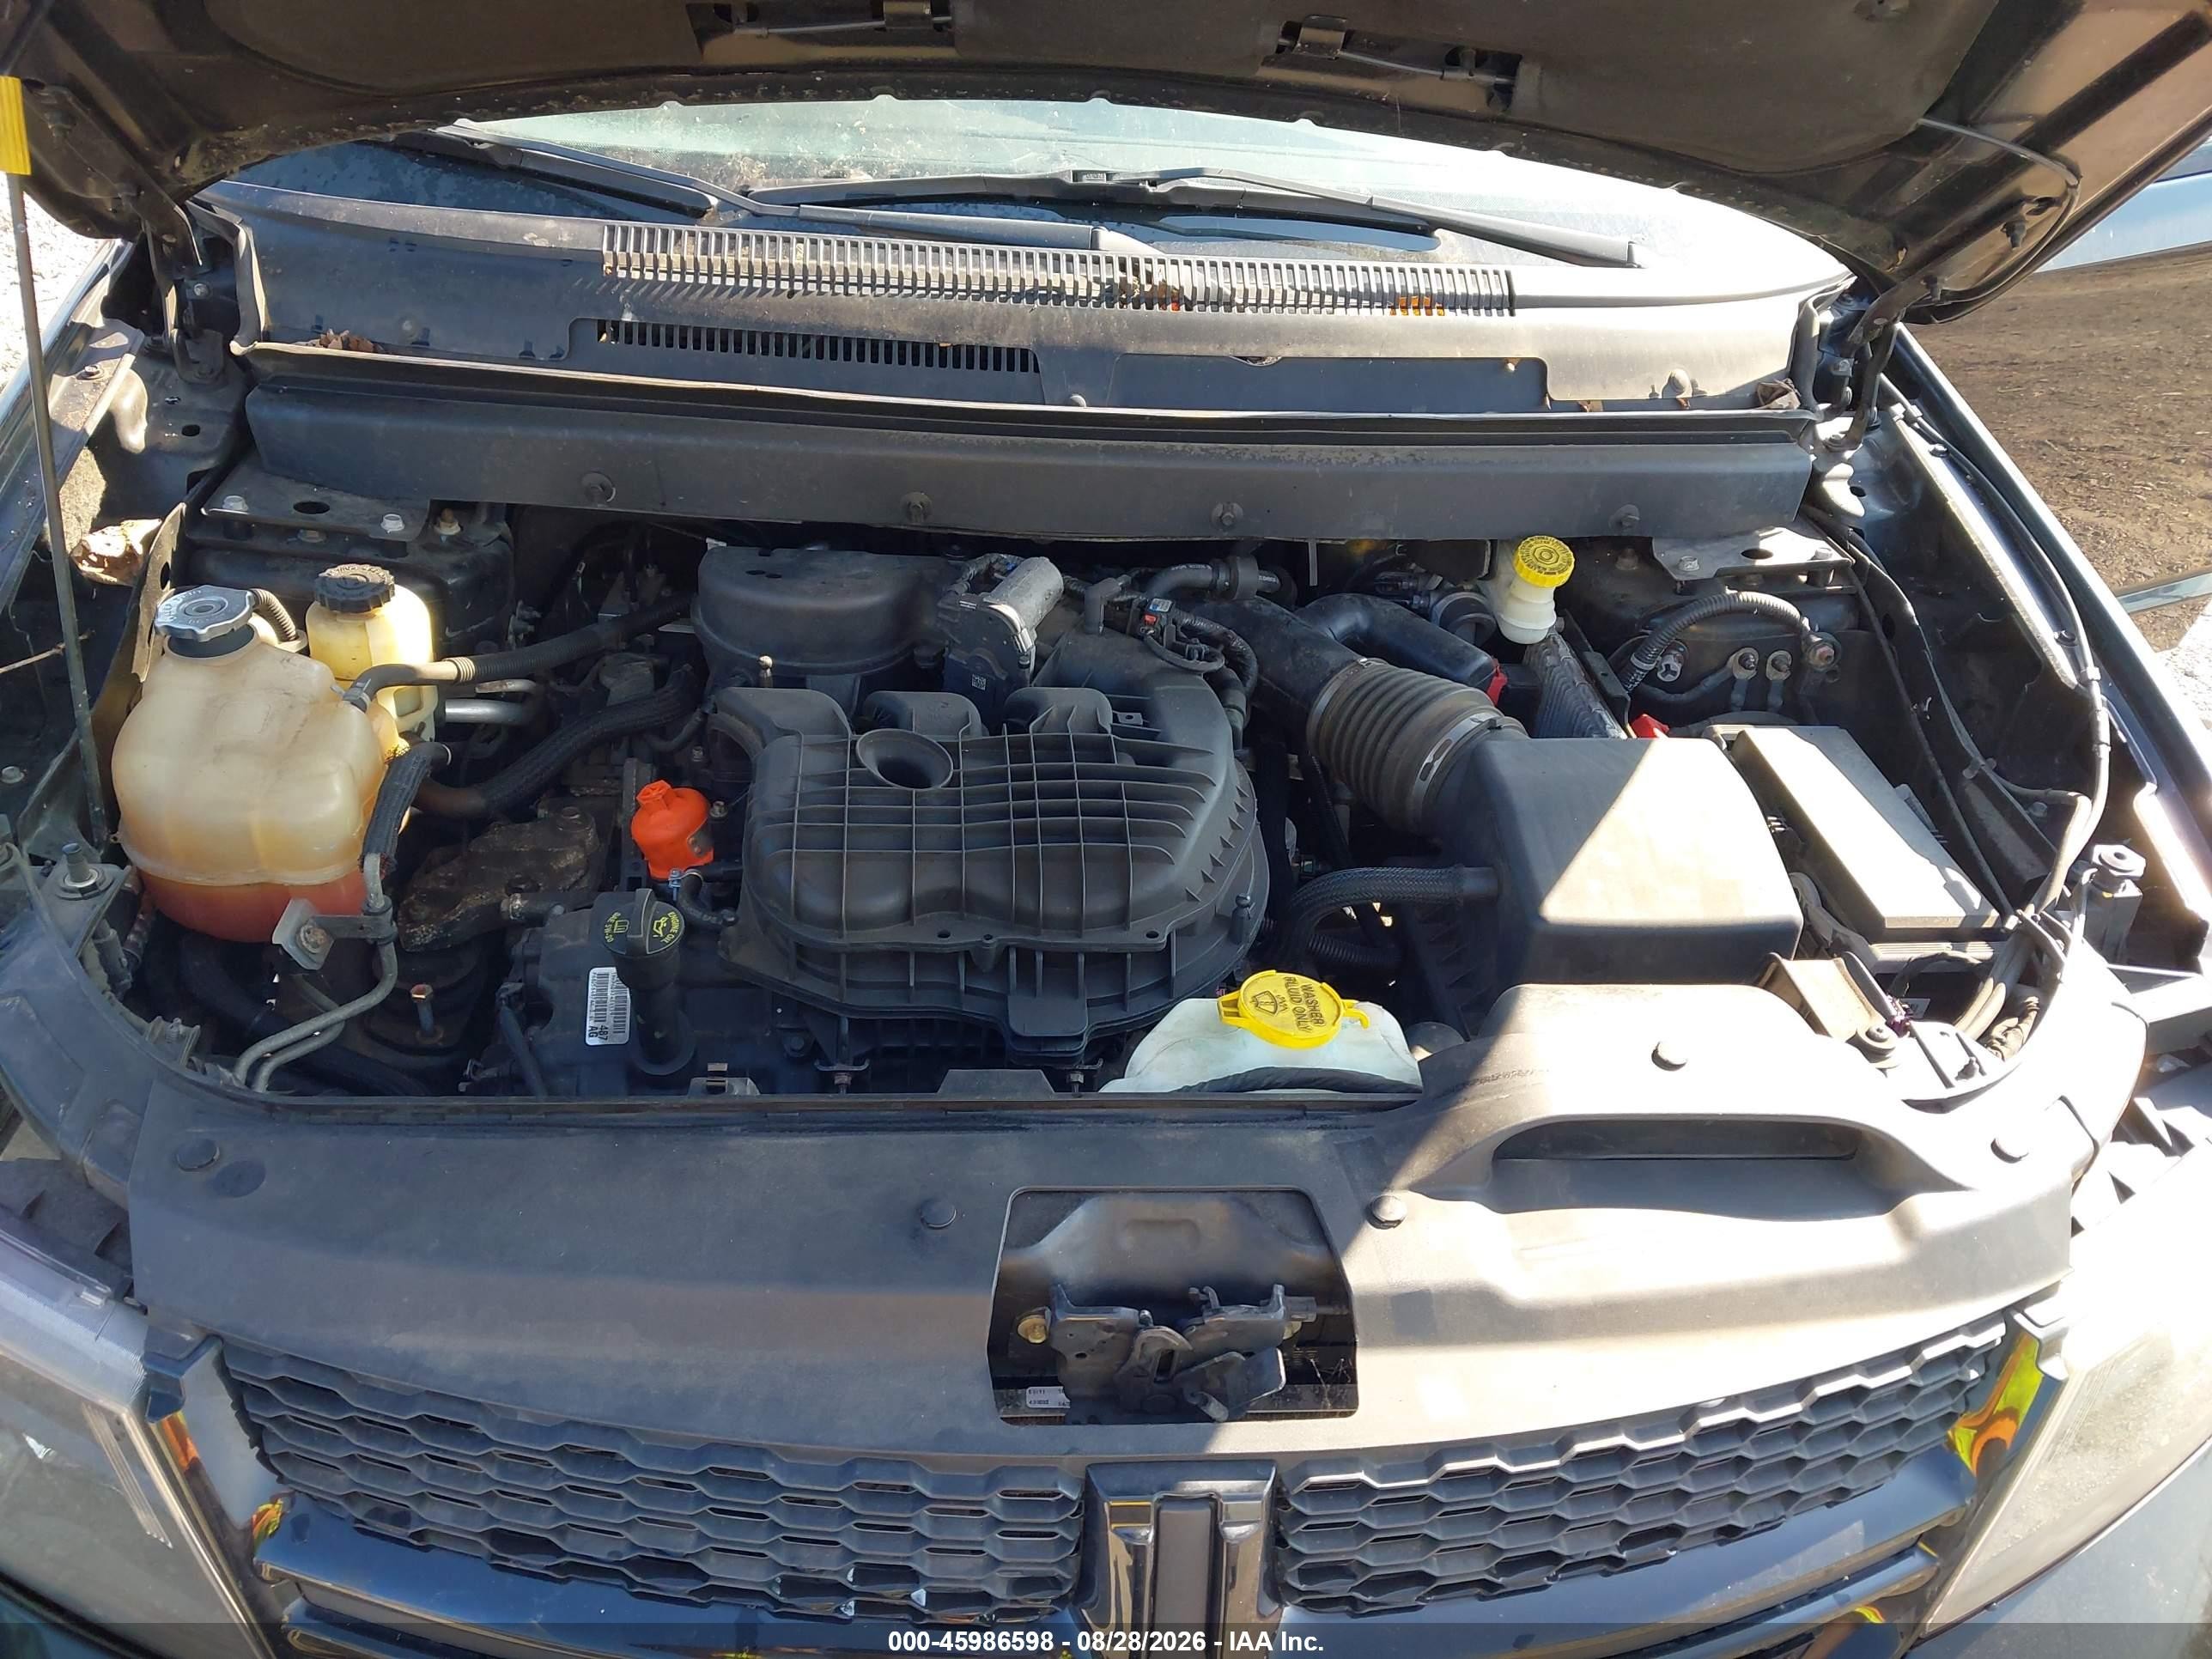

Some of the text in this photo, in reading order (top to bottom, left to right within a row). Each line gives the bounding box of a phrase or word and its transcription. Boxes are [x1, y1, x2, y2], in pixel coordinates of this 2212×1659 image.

[605, 924, 616, 943] 5W-20
[660, 911, 680, 944] ENGINE OIL
[1284, 976, 1312, 1031] FLUID ONLY
[1301, 984, 1324, 1025] WASHER
[588, 1025, 599, 1038] AG
[599, 1024, 609, 1041] 487
